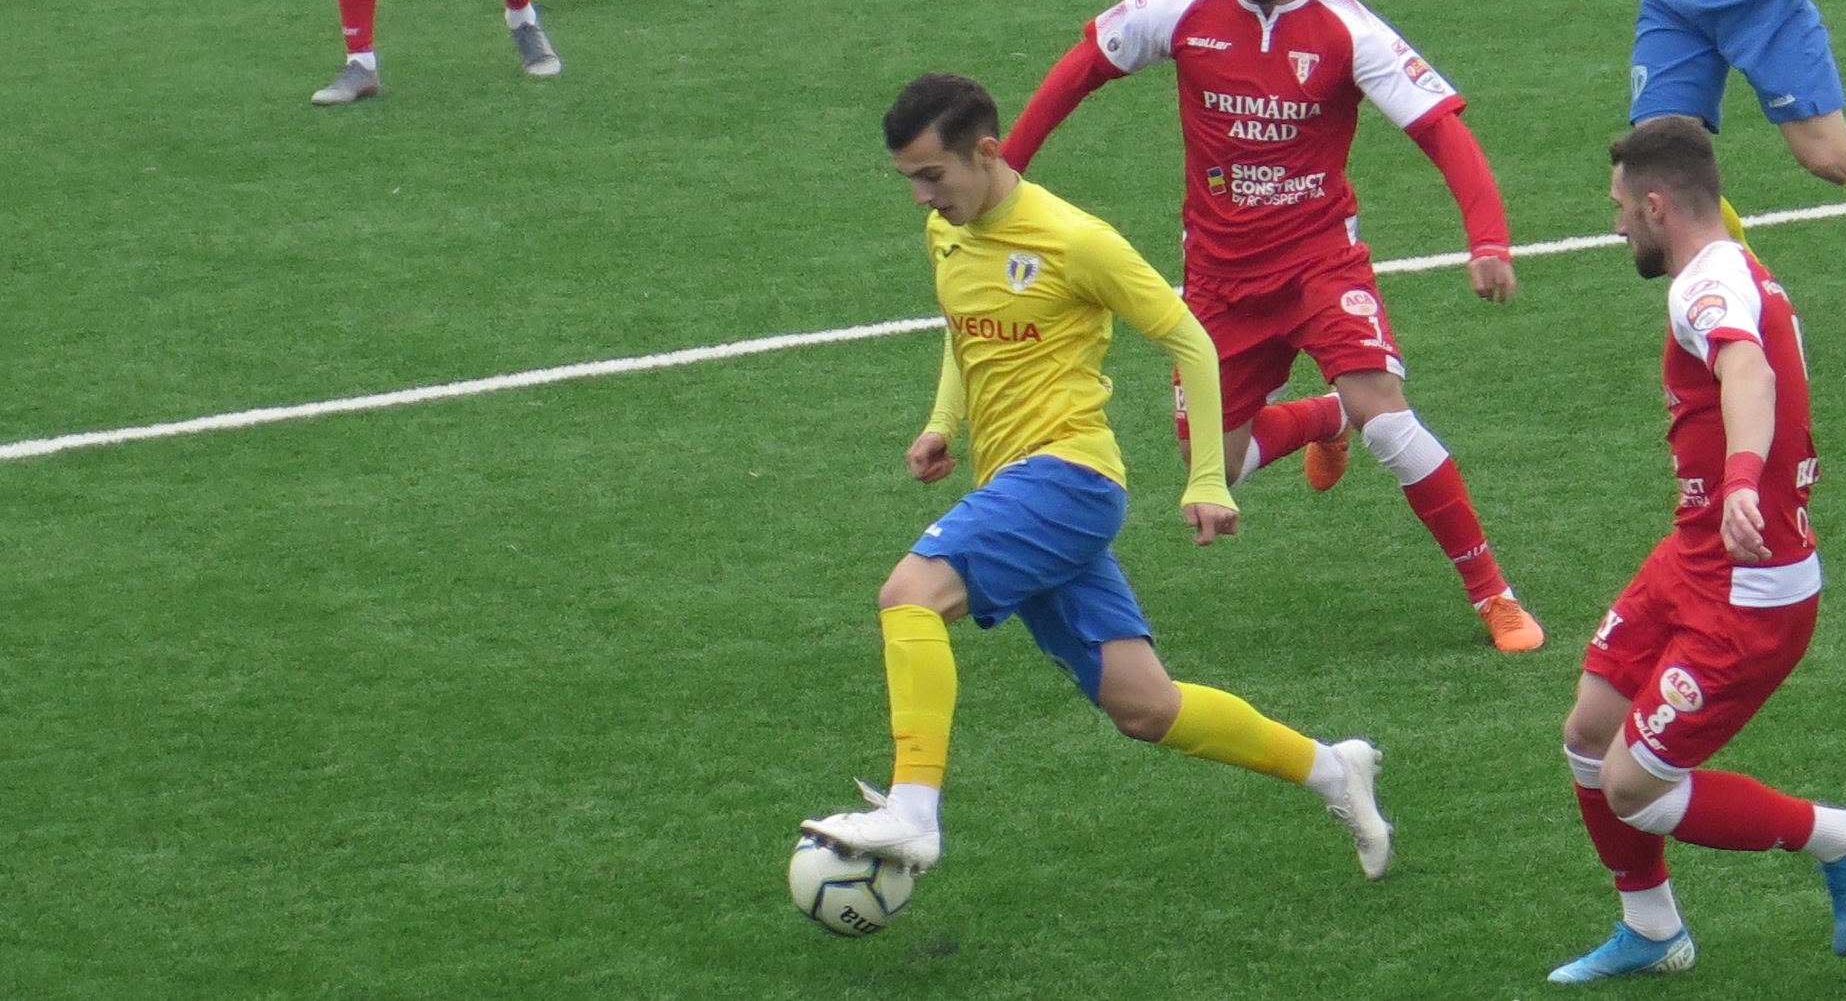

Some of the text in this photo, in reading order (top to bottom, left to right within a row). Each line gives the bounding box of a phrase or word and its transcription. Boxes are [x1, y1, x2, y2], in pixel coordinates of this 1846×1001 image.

[1187, 37, 1232, 50] saller
[1203, 91, 1323, 120] PRIMĂRIA
[1228, 120, 1298, 141] ARAD
[1231, 164, 1286, 181] SHOP
[1231, 172, 1326, 195] CONSTRUCT
[1346, 295, 1373, 307] ACA
[951, 316, 1043, 341] VEOLIA
[1667, 671, 1699, 707] ACA
[1648, 704, 1676, 734] 8
